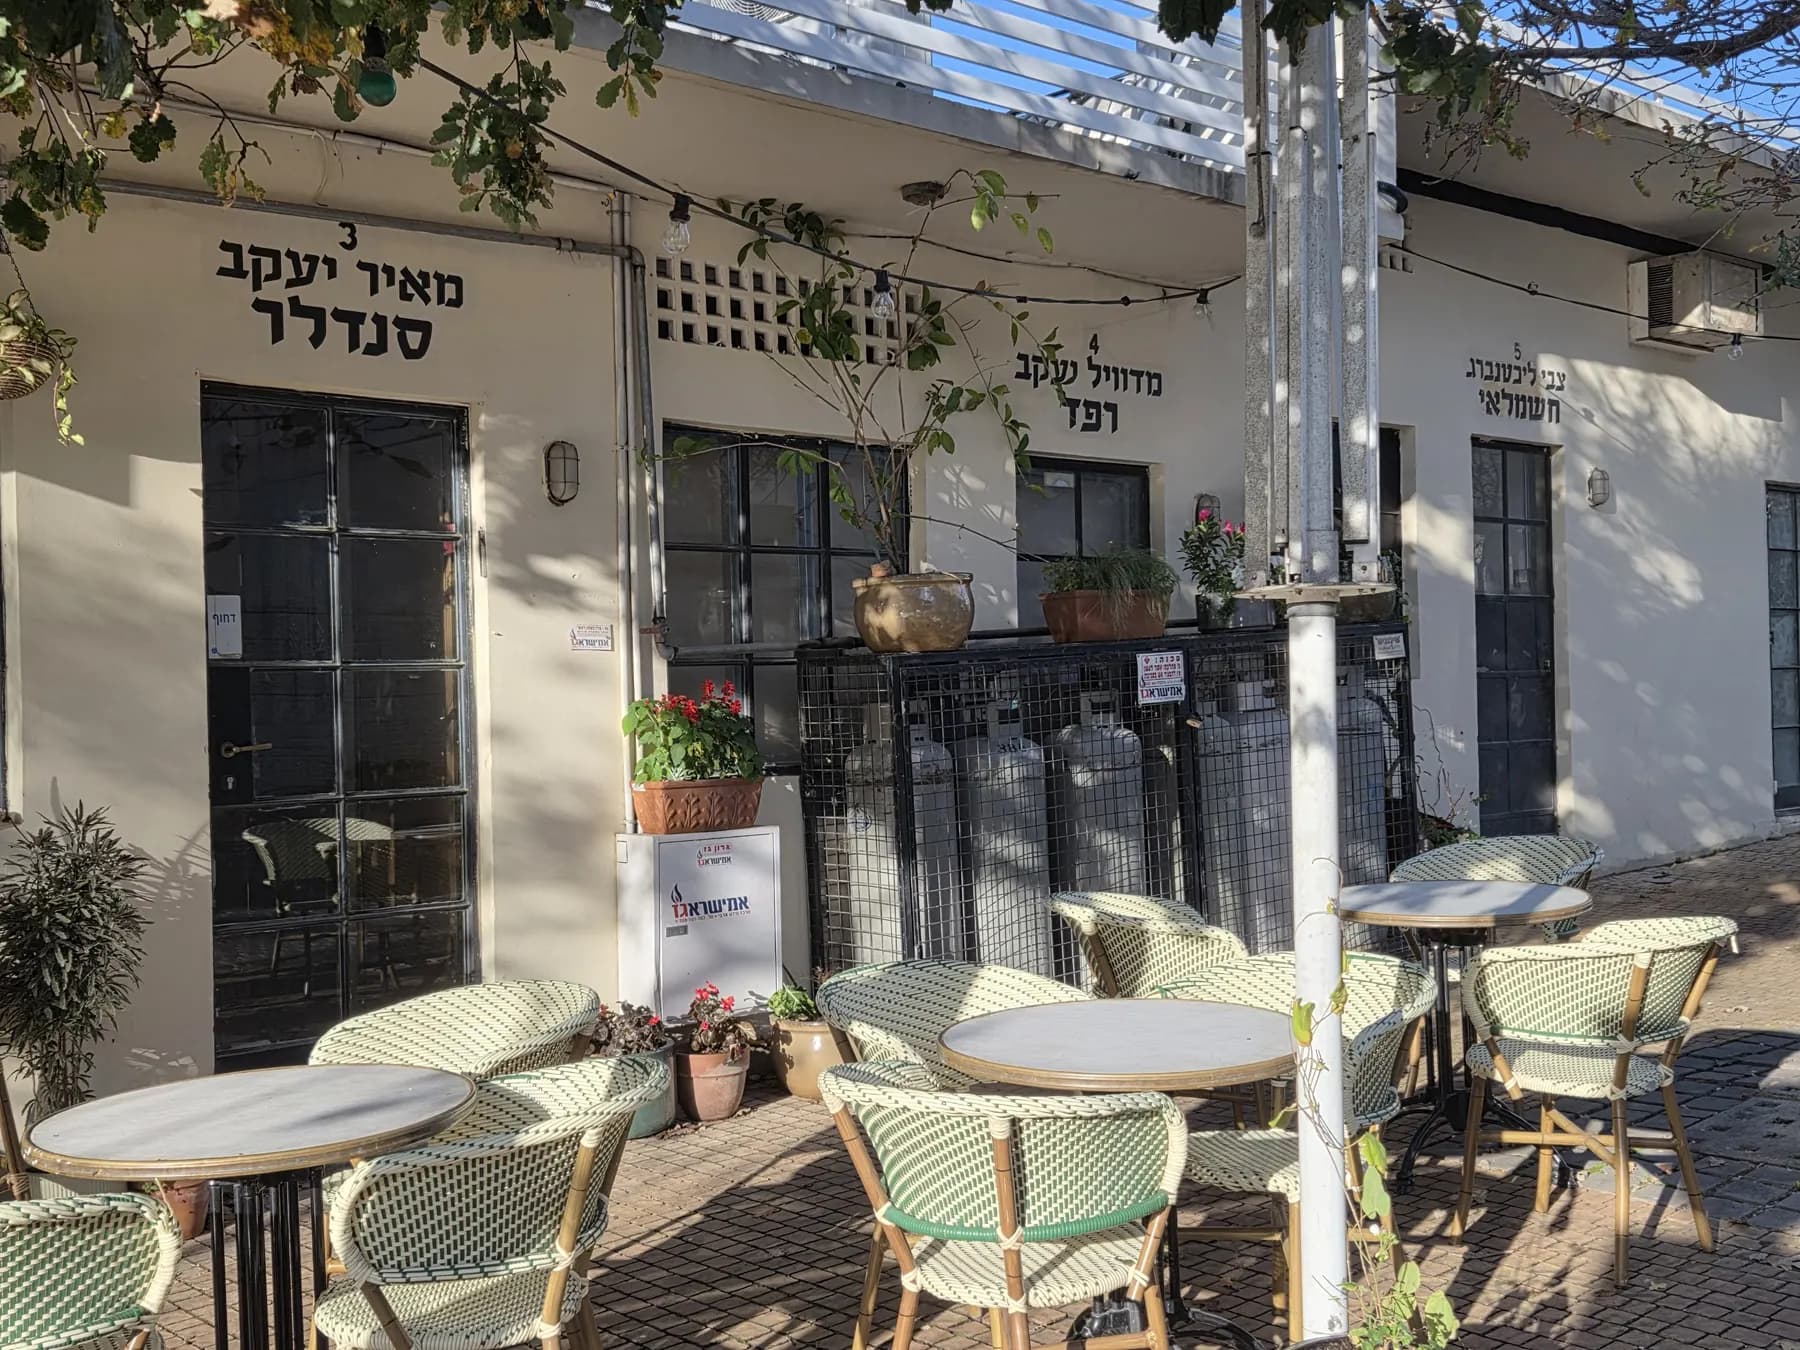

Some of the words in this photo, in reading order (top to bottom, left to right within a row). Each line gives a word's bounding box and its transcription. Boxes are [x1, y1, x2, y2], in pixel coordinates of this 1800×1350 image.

[338, 222, 358, 251] 3
[216, 239, 338, 293] יעקב
[356, 259, 464, 309] מאיר
[251, 295, 433, 360] סנדלר
[1089, 333, 1099, 355] 4
[1514, 342, 1521, 360] 5
[1086, 355, 1162, 397] מדוויל
[1541, 370, 1566, 392] צבי
[1064, 397, 1118, 434] רפד
[1479, 388, 1560, 424] חשמלאי
[212, 613, 236, 626] דחוף
[672, 895, 750, 919] אמישראגז
